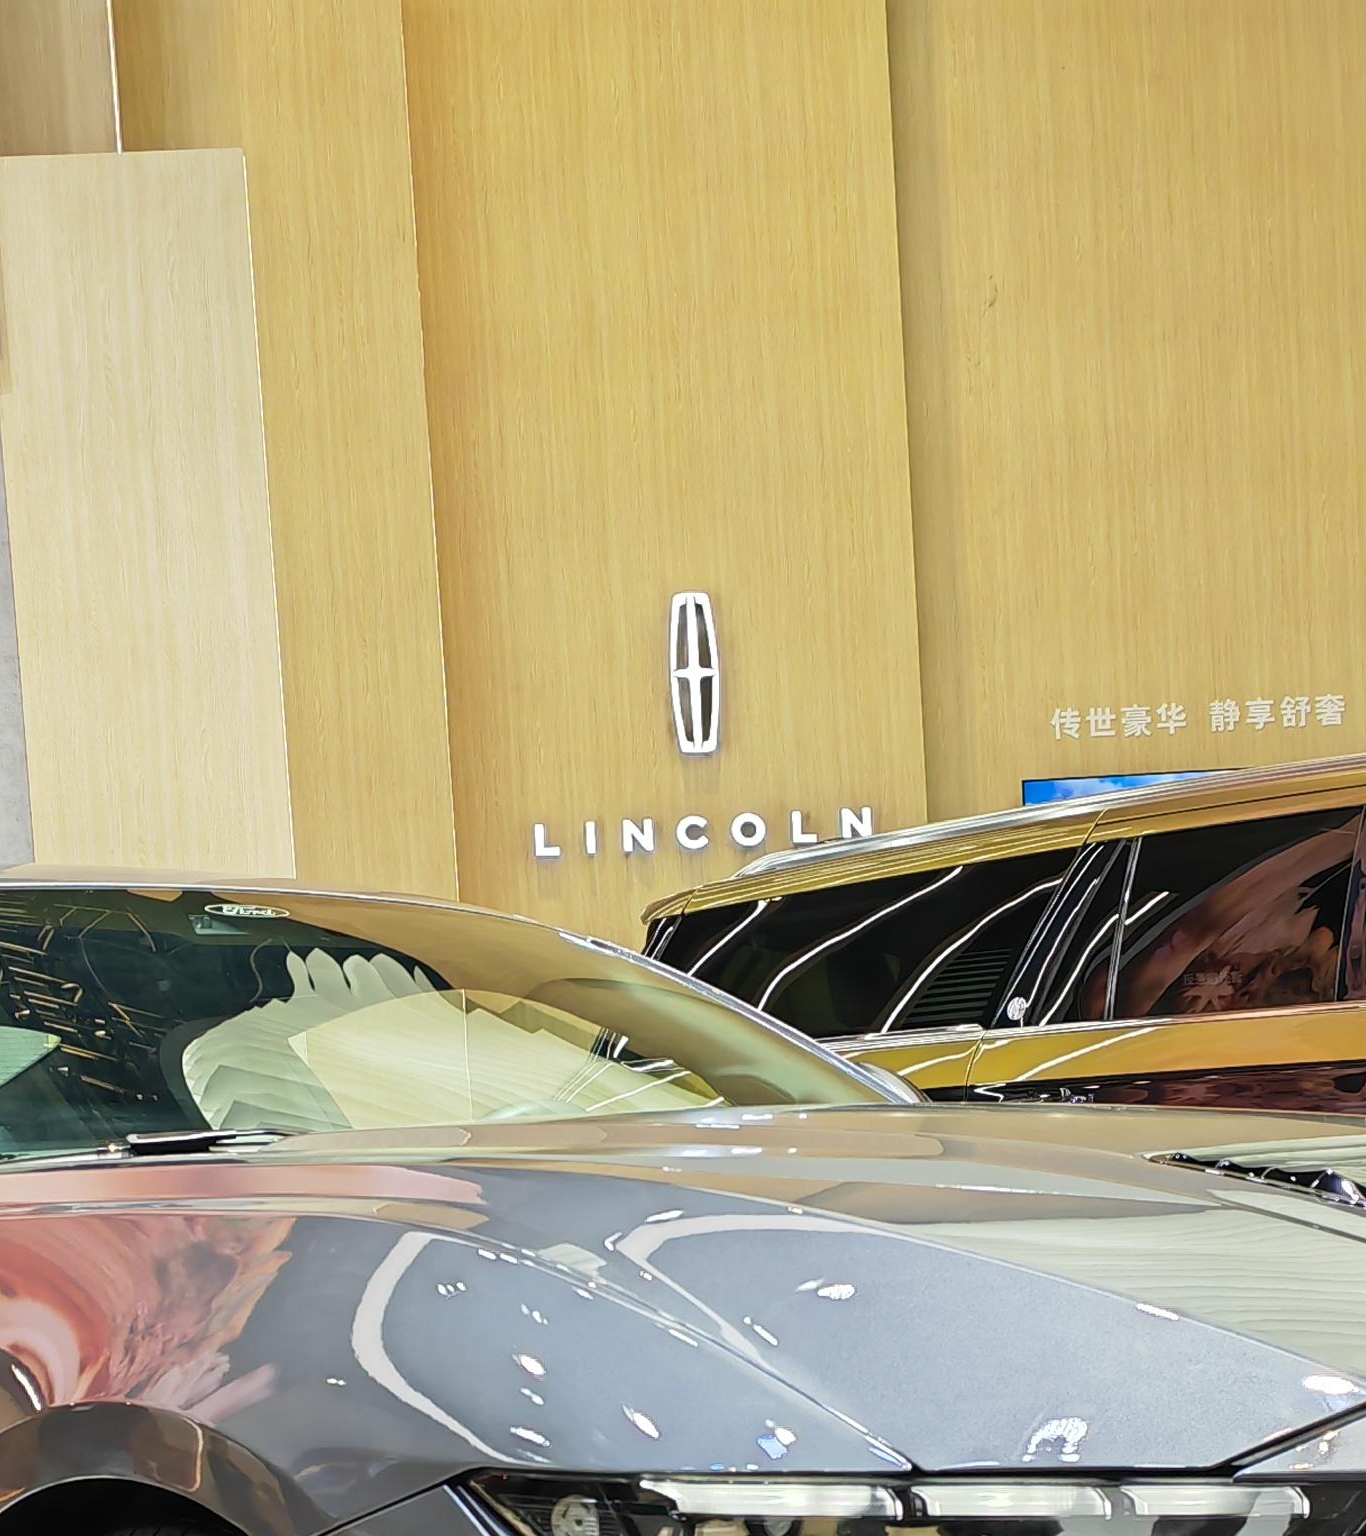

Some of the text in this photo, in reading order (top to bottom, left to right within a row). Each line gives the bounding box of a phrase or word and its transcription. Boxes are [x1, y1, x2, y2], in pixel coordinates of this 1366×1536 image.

[1050, 693, 1346, 741] 传世豪华 静享舒奢
[533, 806, 876, 858] LINCOLN
